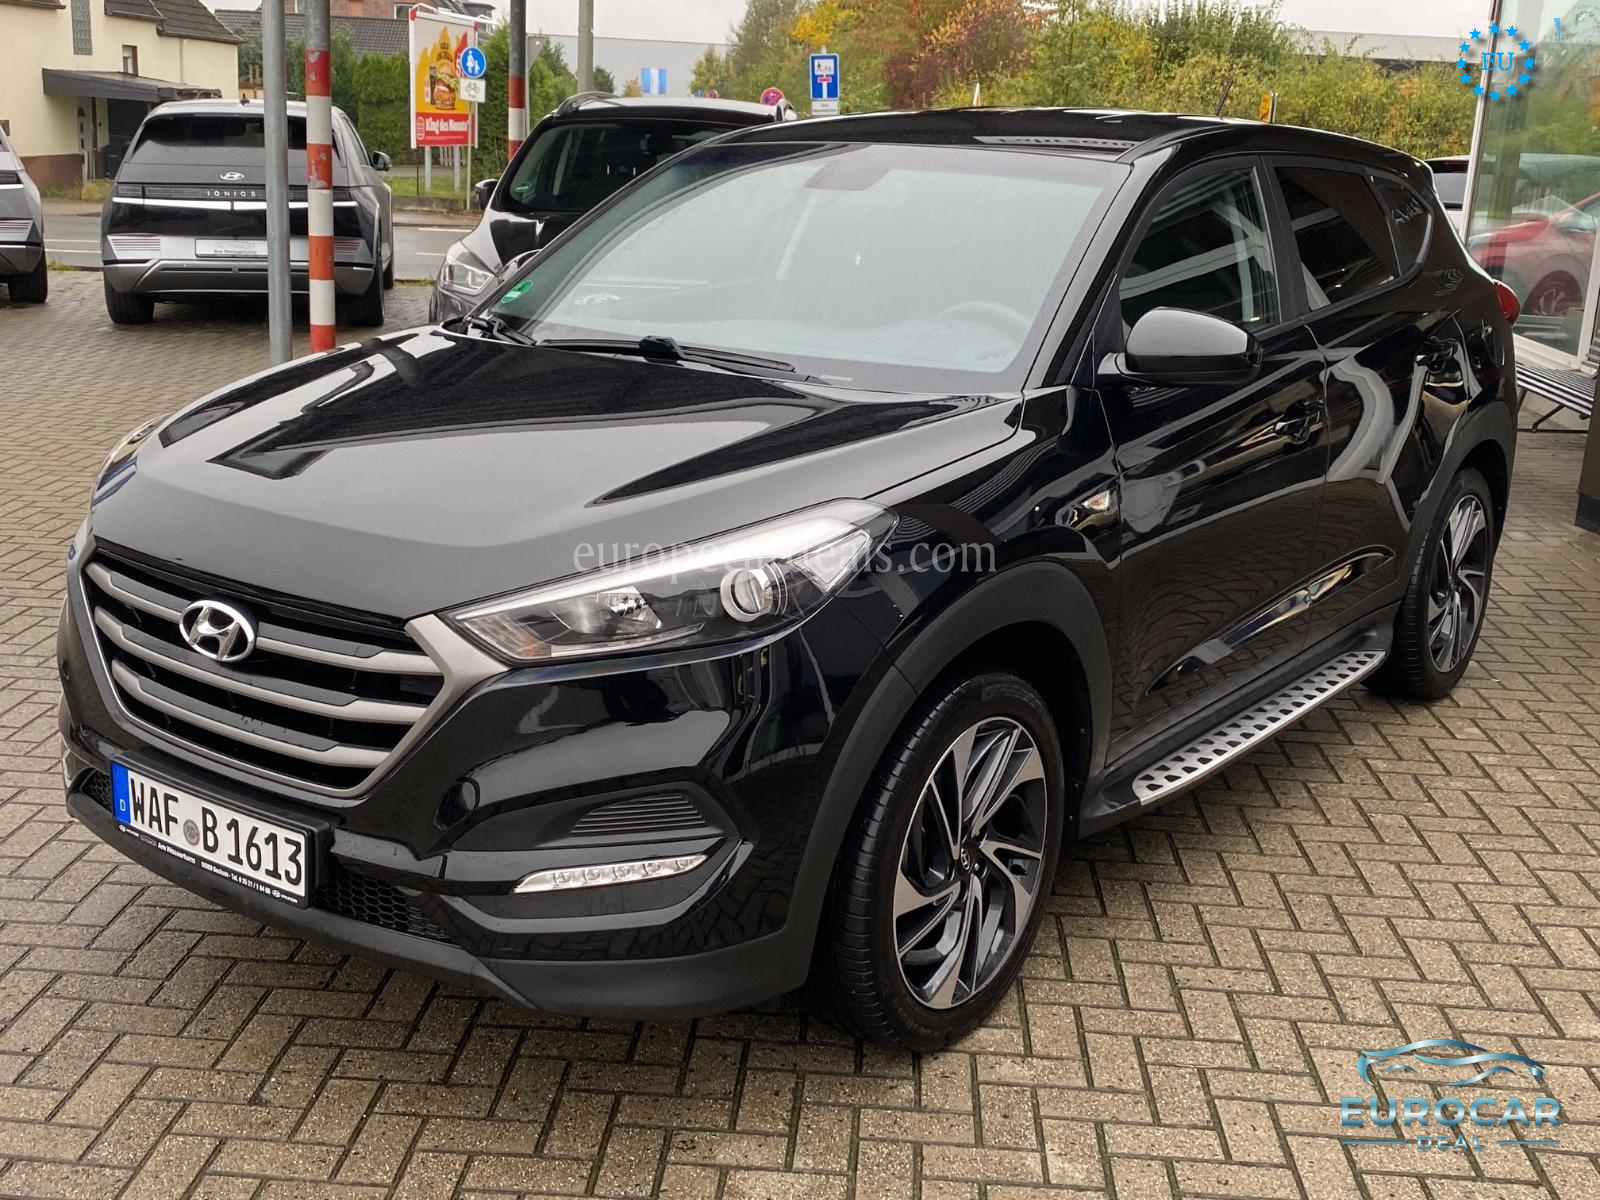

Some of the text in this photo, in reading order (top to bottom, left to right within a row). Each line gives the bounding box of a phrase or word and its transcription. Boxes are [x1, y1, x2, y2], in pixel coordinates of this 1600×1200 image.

[119, 798, 126, 812] D
[130, 778, 302, 886] WAF B 1613
